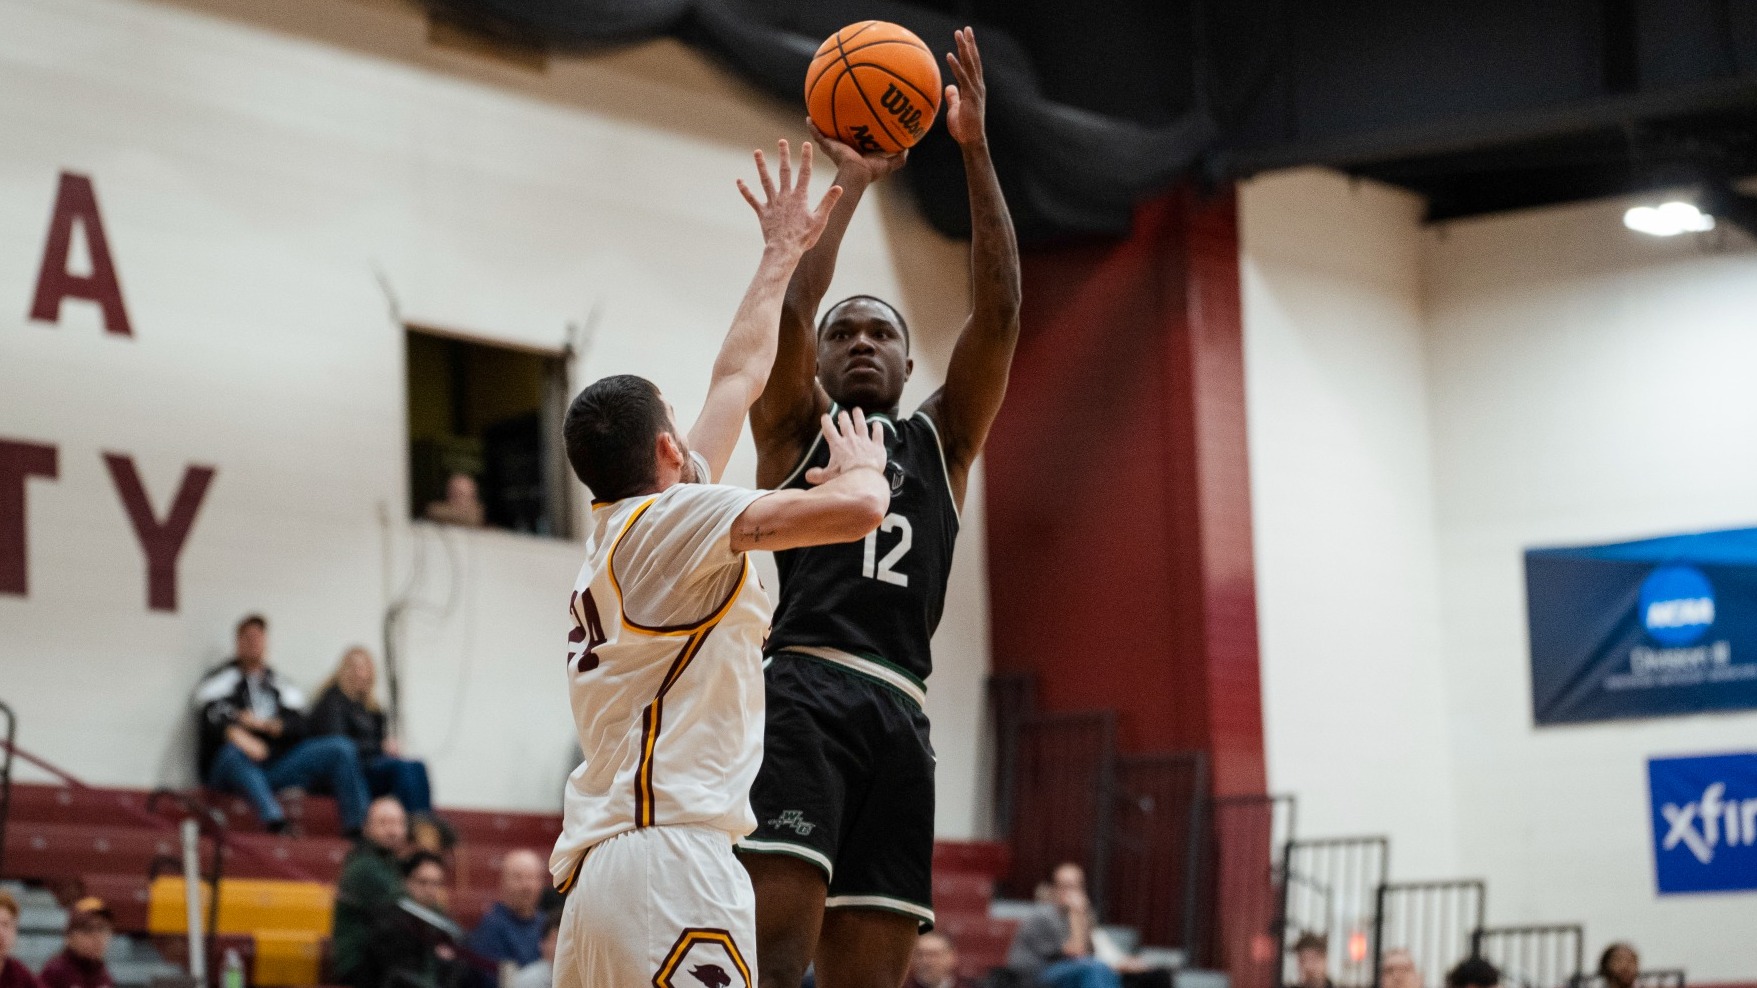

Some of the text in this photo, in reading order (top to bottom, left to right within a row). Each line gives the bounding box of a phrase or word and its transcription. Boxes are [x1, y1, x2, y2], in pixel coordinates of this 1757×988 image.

[29, 171, 135, 338] A
[0, 437, 216, 613] TY
[862, 512, 913, 588] 12
